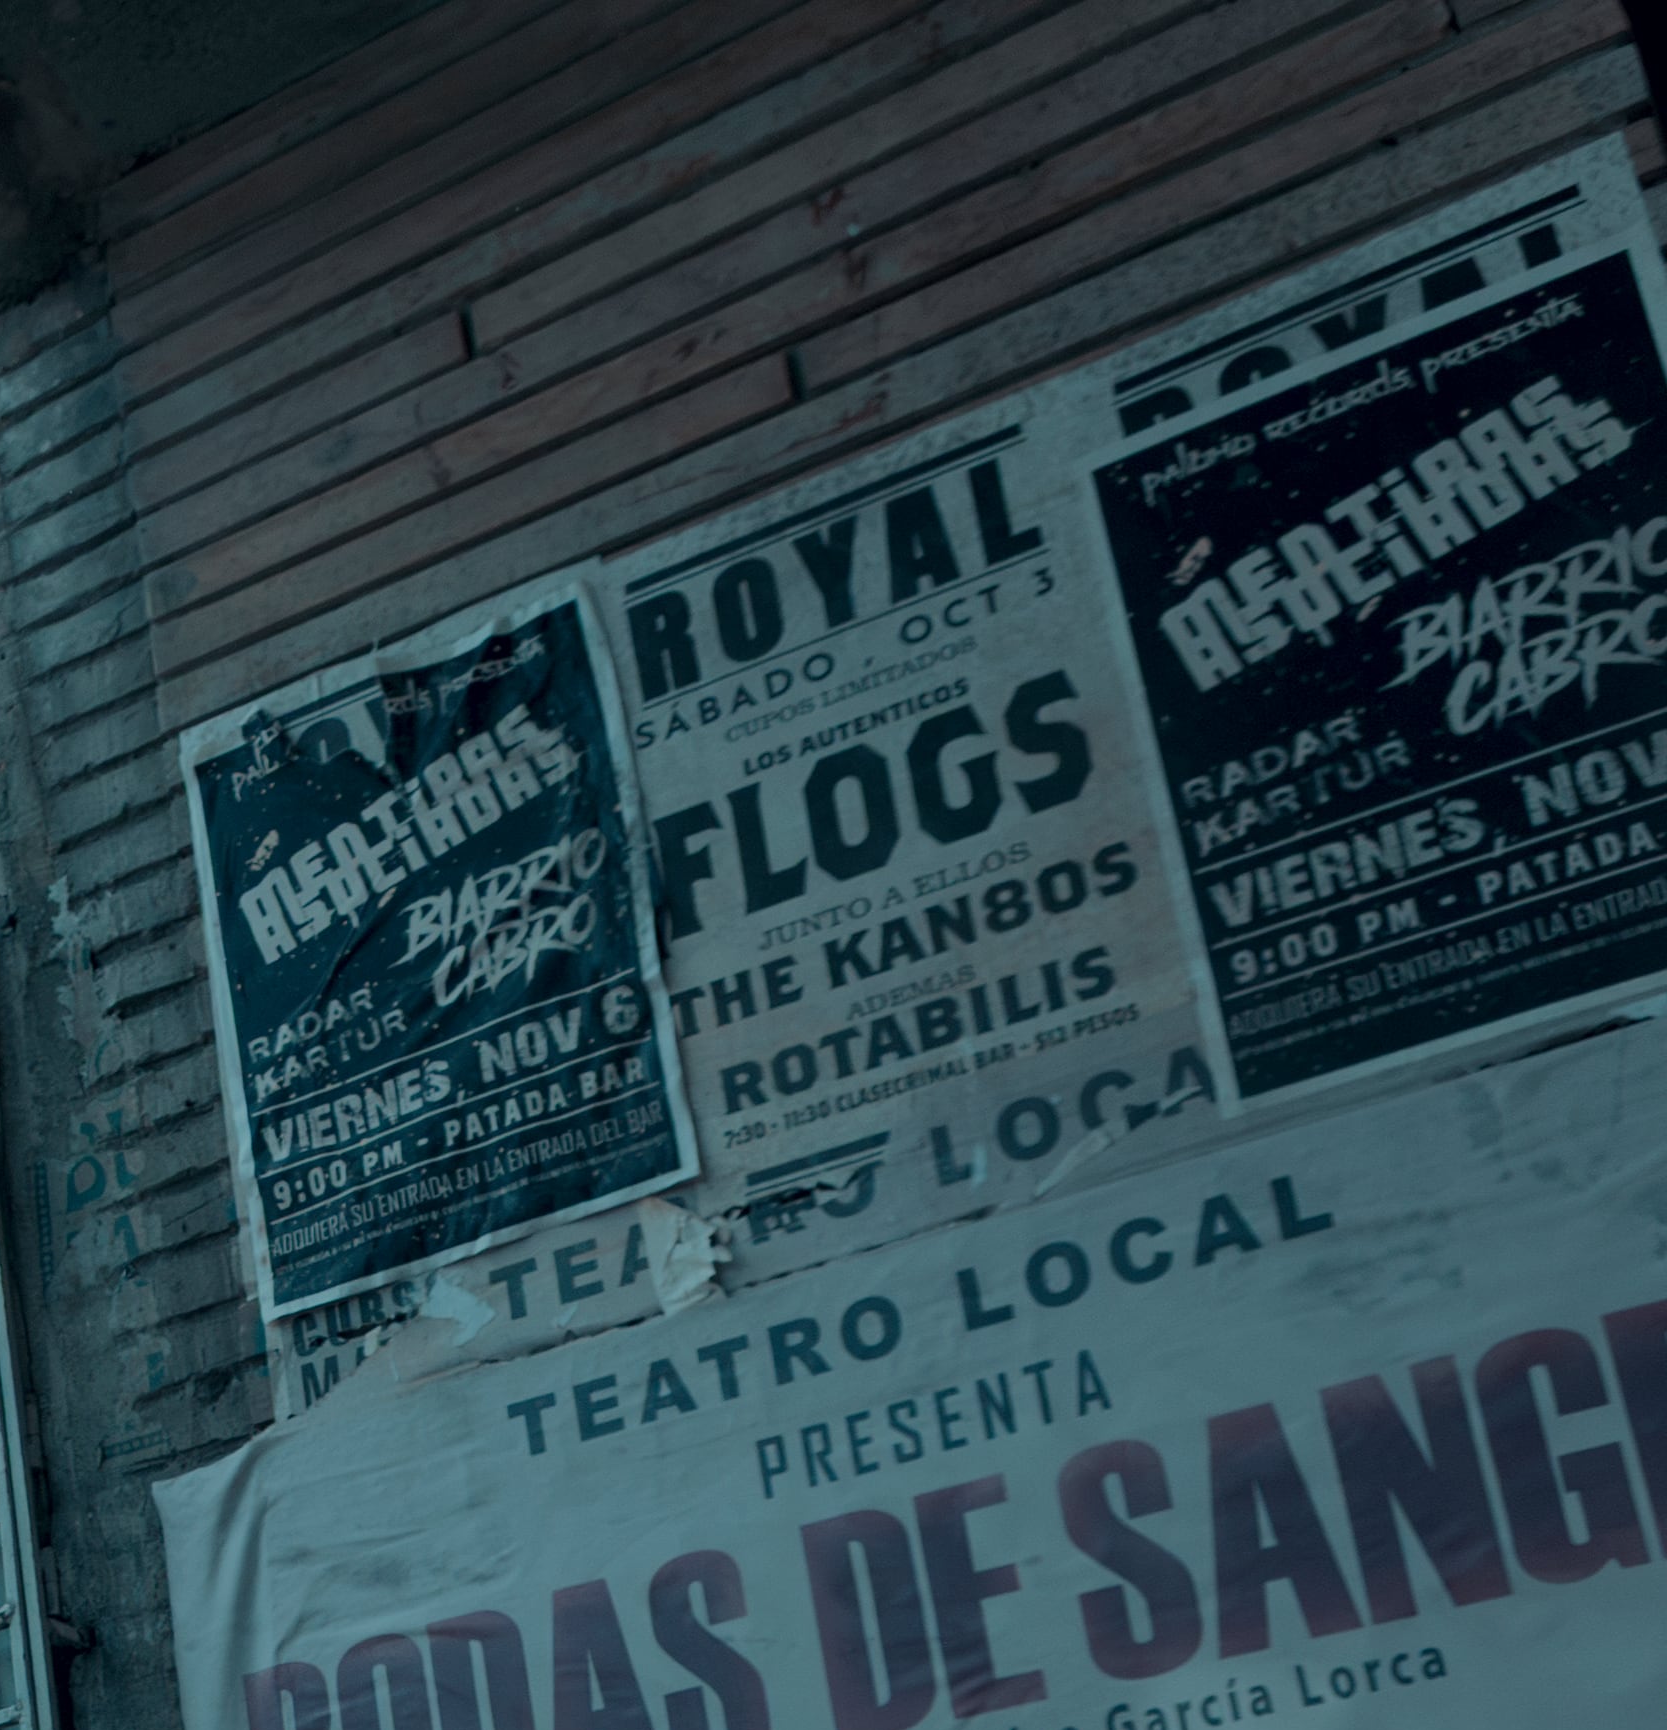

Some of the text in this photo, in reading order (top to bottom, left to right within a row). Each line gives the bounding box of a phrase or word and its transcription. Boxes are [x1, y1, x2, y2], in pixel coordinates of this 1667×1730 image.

[627, 459, 1042, 700] ROYAL
[900, 585, 1001, 645] OCT
[1034, 567, 1055, 596] 3
[725, 636, 978, 743] CUPOS LIMITADOS
[744, 677, 970, 777] LOS AUTENTICOS
[654, 669, 1094, 941] FLOGS
[1180, 712, 1364, 807] RADAR
[758, 841, 1033, 951] JUNTO A ELLOS
[1230, 922, 1338, 984] 9:00
[1356, 898, 1420, 944] PM
[1475, 821, 1659, 904] PATADA
[249, 987, 376, 1063] RADAR
[479, 1006, 582, 1084] NOV
[601, 983, 640, 1036] 6
[669, 955, 804, 1042] THE
[719, 945, 1117, 1117] ROTABILIS
[846, 964, 978, 1022] ADEMAS
[723, 1122, 766, 1149] 7:30
[974, 1042, 1017, 1070] BAR
[1071, 1003, 1140, 1040] PESOS
[273, 1159, 347, 1211] 9:00
[362, 1140, 404, 1177] PM
[442, 1082, 568, 1147] PATADA
[579, 1056, 644, 1100] BAR
[350, 1200, 375, 1229] SU
[378, 1173, 454, 1218] ENTRADA
[456, 1164, 481, 1190] EN
[482, 1156, 505, 1182] LA
[506, 1128, 588, 1173] ENTRADA
[588, 1117, 625, 1147] DEL
[625, 1100, 664, 1135] BAR
[507, 1295, 902, 1456] TEATRO
[956, 1175, 1334, 1332] LOCAL
[755, 1350, 1113, 1500] PRESENTA
[1297, 1643, 1449, 1710] Lorca
